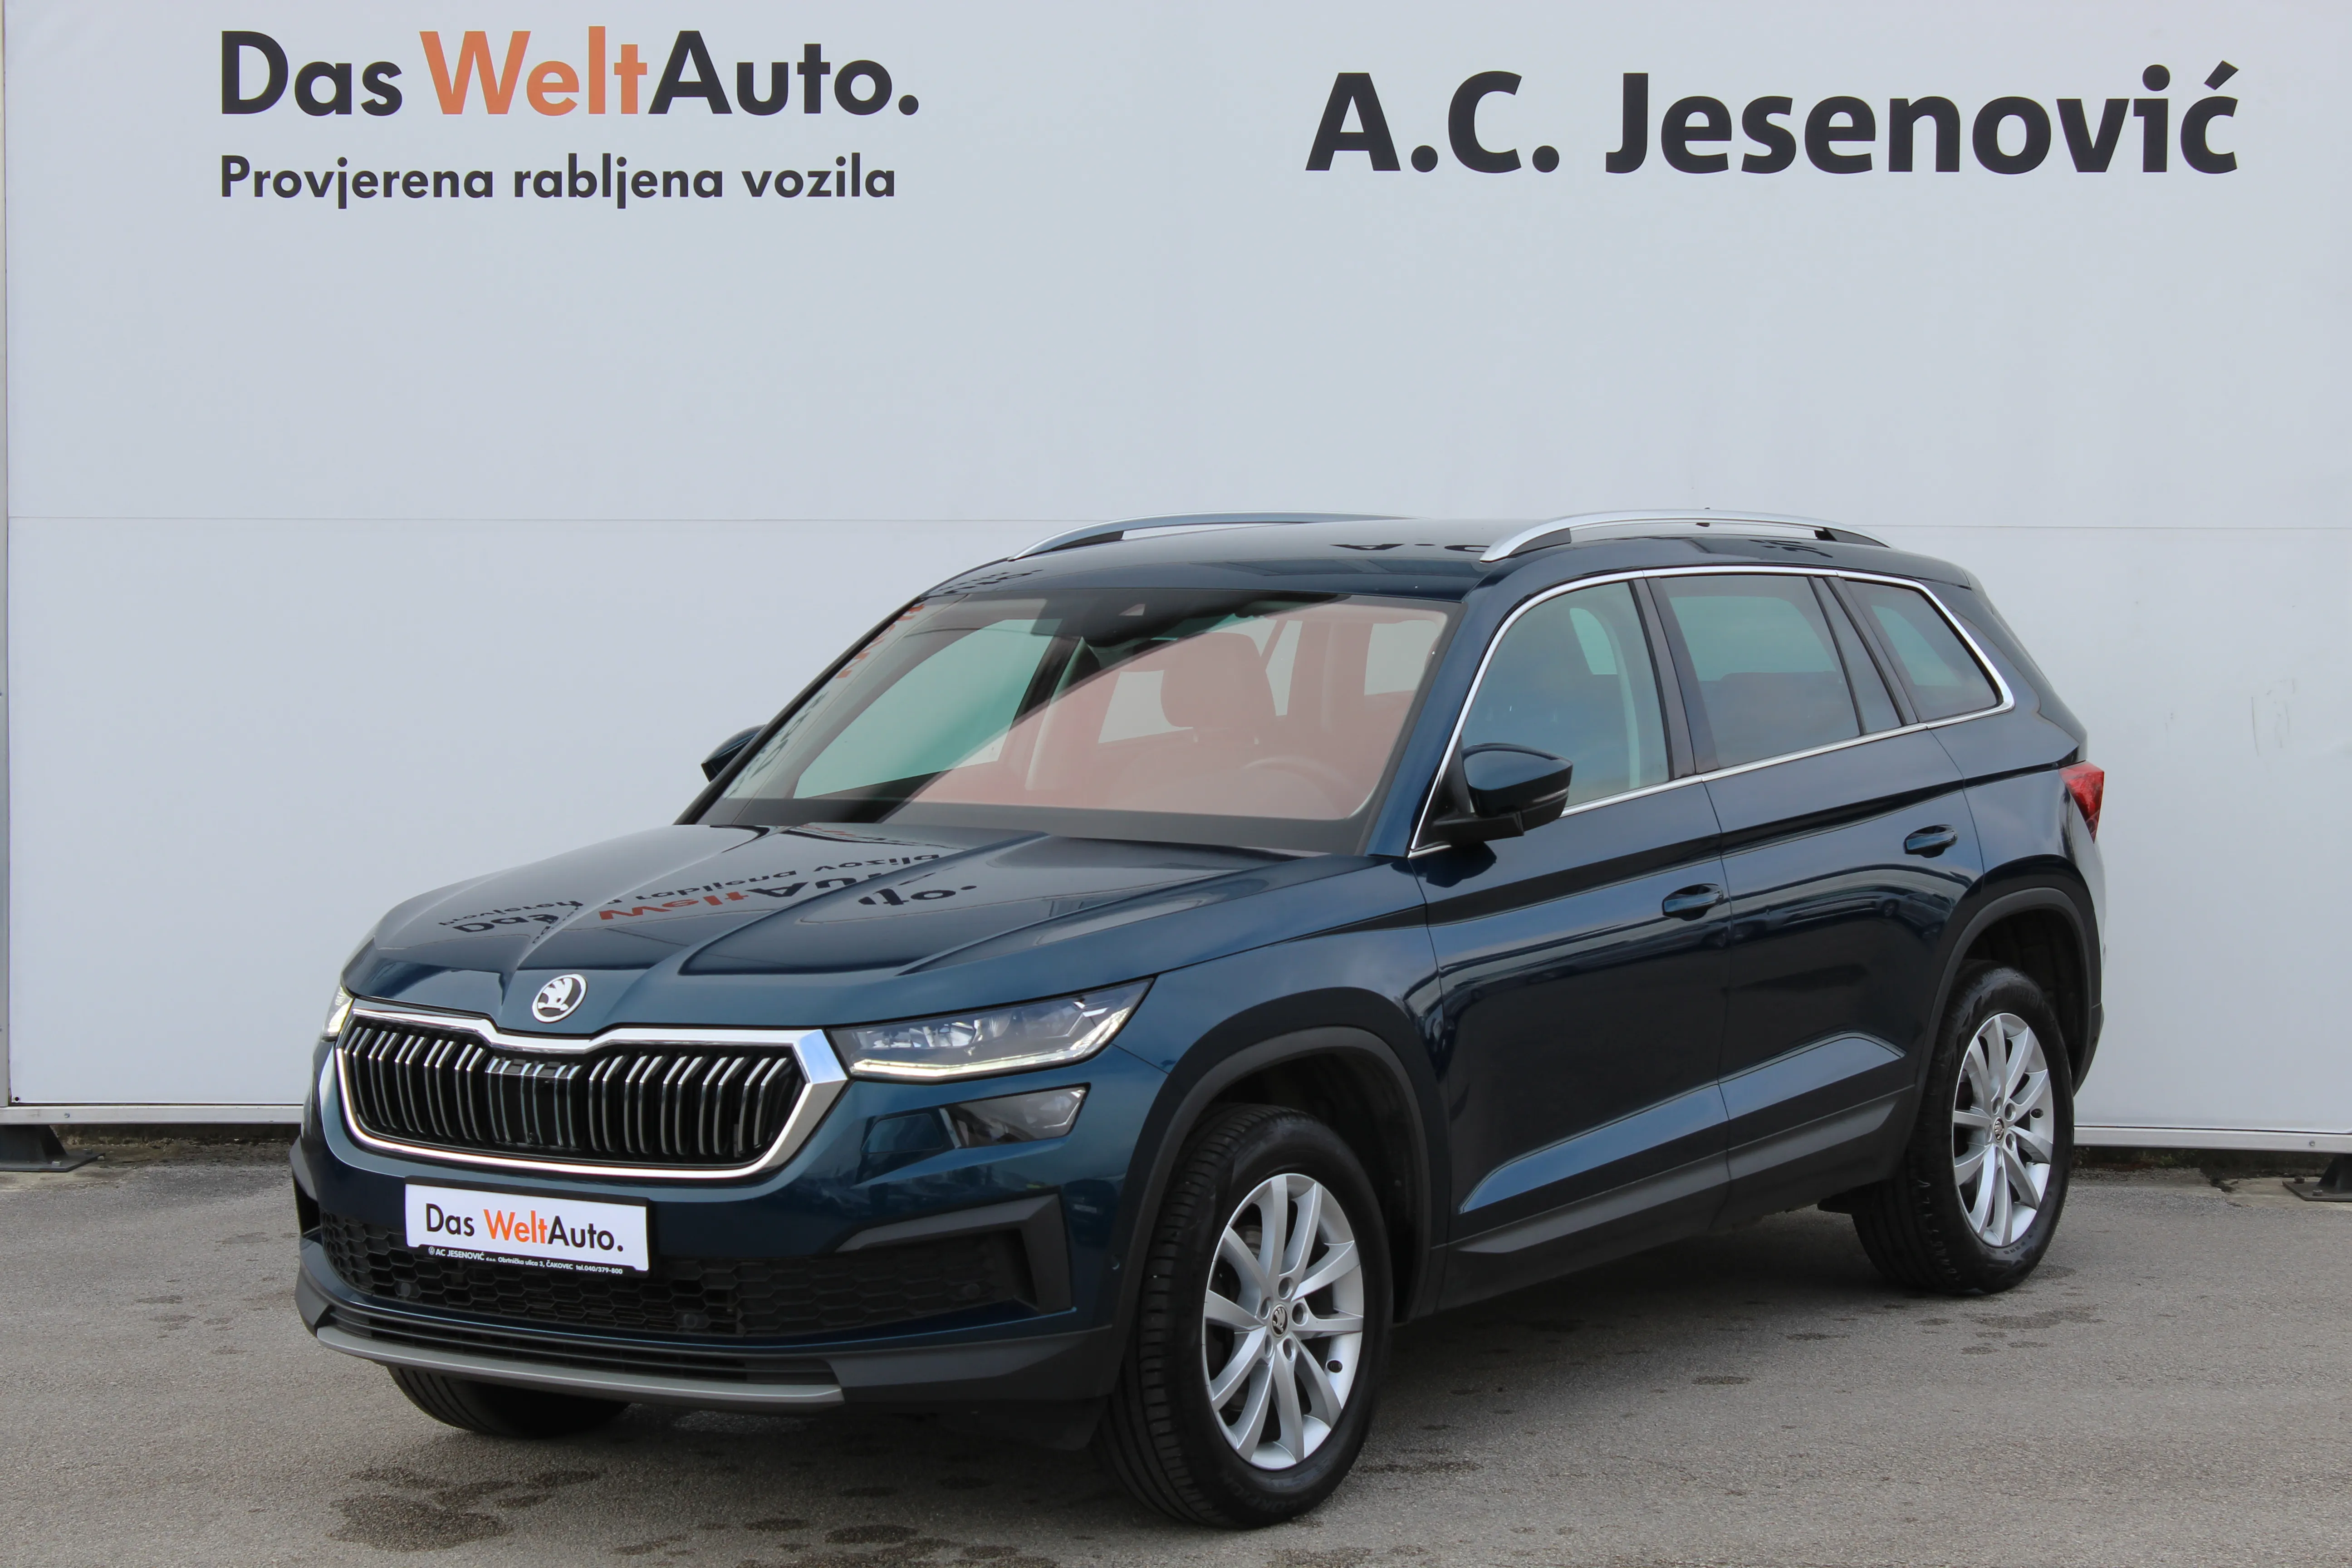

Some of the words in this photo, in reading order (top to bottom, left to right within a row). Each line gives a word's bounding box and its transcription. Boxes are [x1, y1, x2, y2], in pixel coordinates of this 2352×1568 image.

[221, 30, 402, 116] Das
[419, 26, 919, 116] WeltAuto.
[1305, 71, 1559, 174] A.C.
[1606, 60, 2239, 175] Jesenović
[221, 155, 493, 209] Provjerena
[514, 153, 722, 209] rabljena
[741, 152, 894, 198] vozila
[426, 1203, 475, 1237] Das
[483, 1209, 624, 1252] WeltAuto.
[447, 1250, 485, 1261] JESENOVIĆ
[498, 1256, 524, 1265] Obrtnička
[546, 1260, 573, 1269] ČAKOVEC
[576, 1264, 623, 1274] tel.040/379-800
